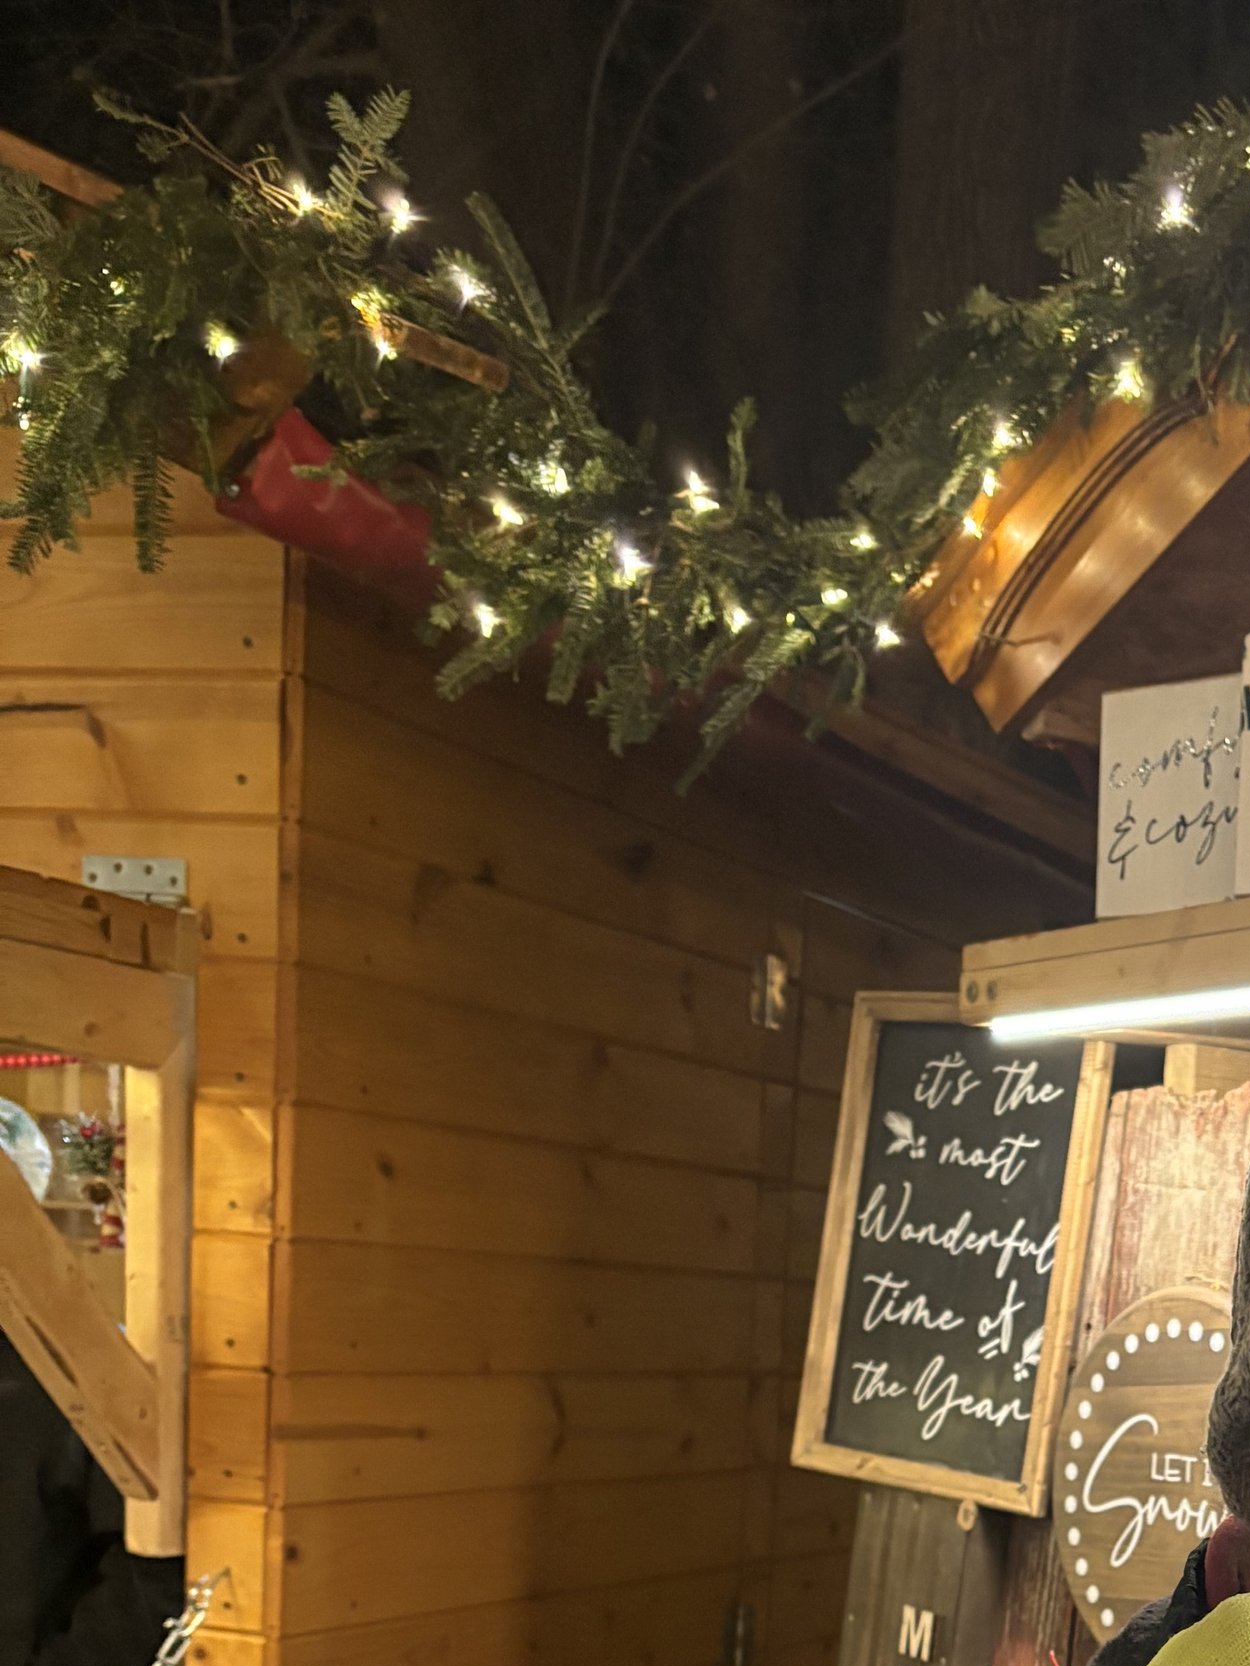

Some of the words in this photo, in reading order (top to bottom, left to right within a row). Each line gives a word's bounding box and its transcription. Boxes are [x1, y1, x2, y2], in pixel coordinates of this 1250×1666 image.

[914, 1051, 981, 1110] it's
[992, 1060, 1065, 1116] the
[938, 1133, 1041, 1186] most
[858, 1180, 1062, 1279] Wonderful
[977, 1279, 1026, 1354] of
[852, 1360, 908, 1404] the
[913, 1355, 1032, 1441] Year
[1151, 1452, 1198, 1483] LET
